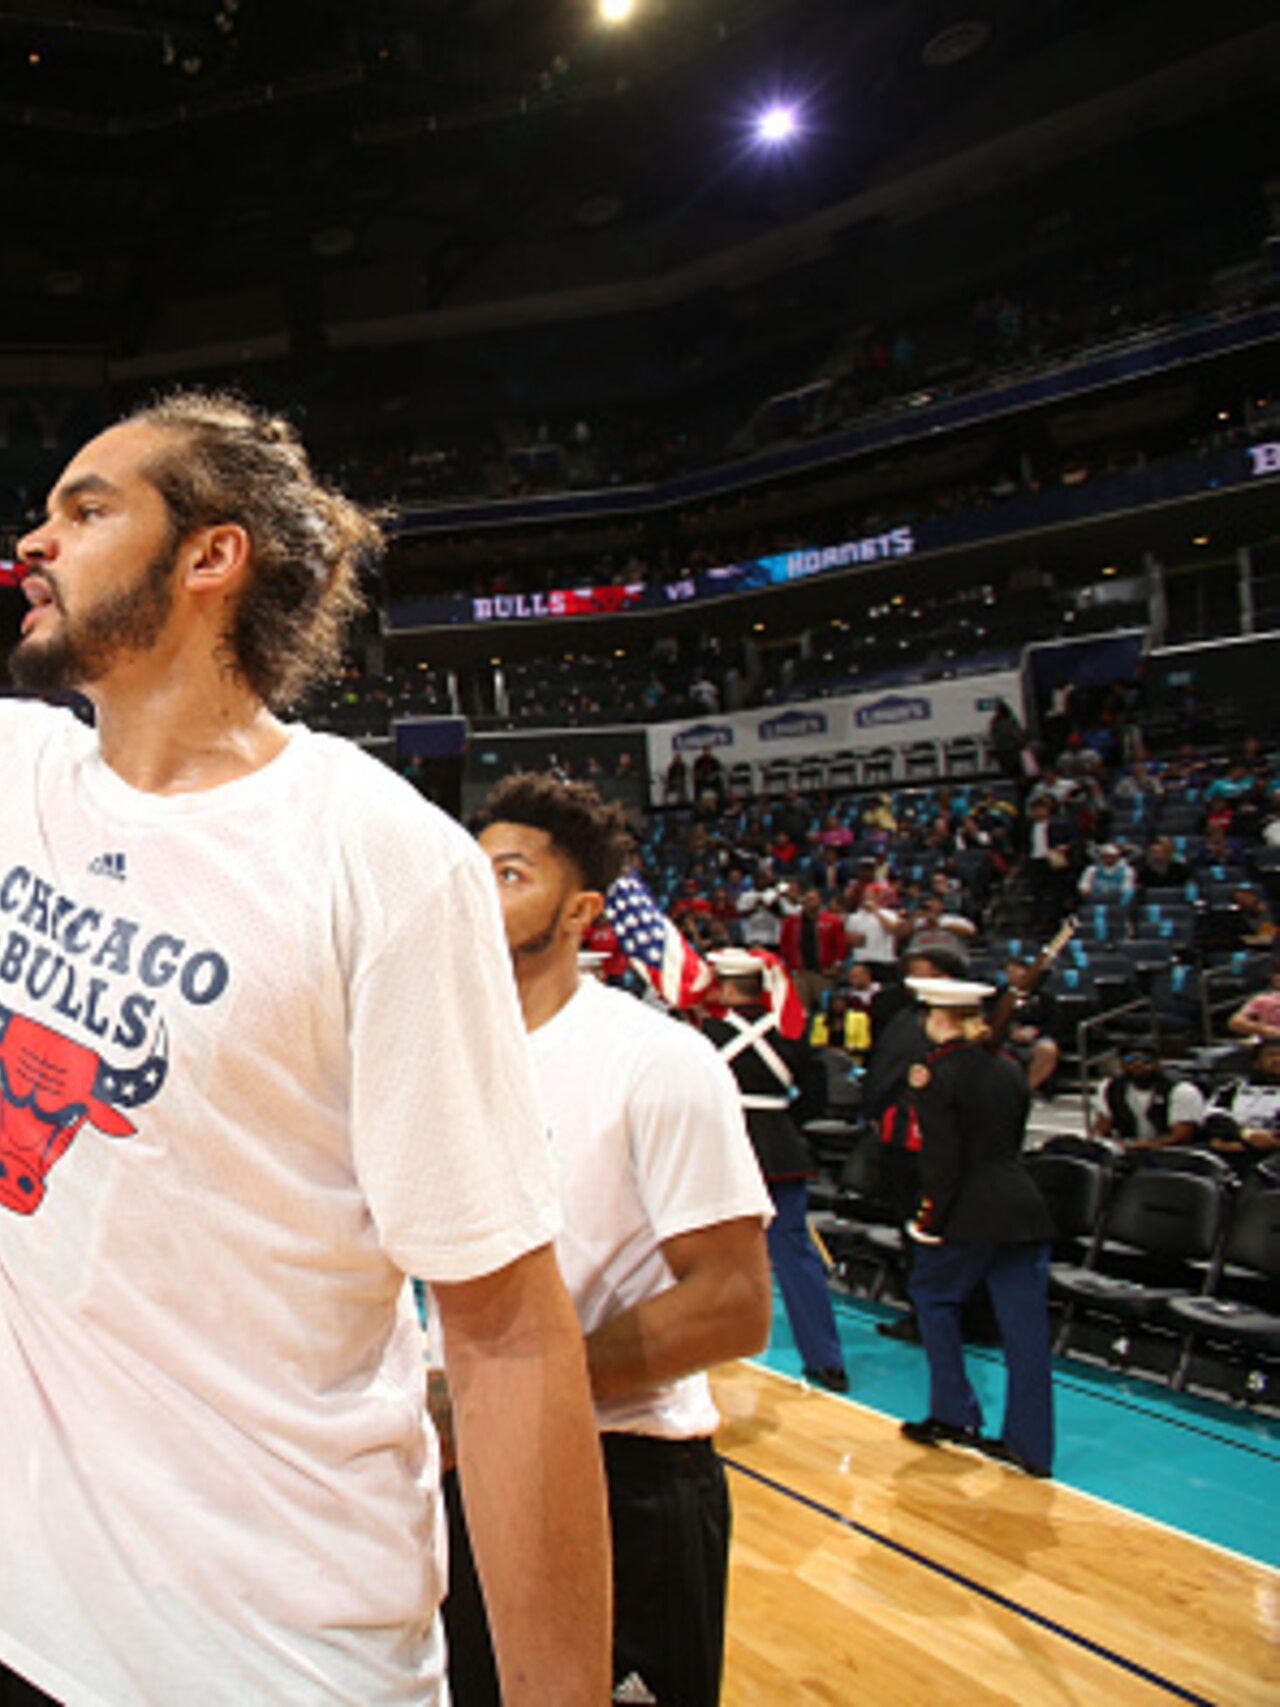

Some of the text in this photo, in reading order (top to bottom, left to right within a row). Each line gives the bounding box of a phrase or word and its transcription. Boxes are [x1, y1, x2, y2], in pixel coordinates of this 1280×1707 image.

[473, 592, 567, 620] BULLS
[786, 526, 915, 580] HORNETS
[0, 866, 229, 1005] CHICAGO
